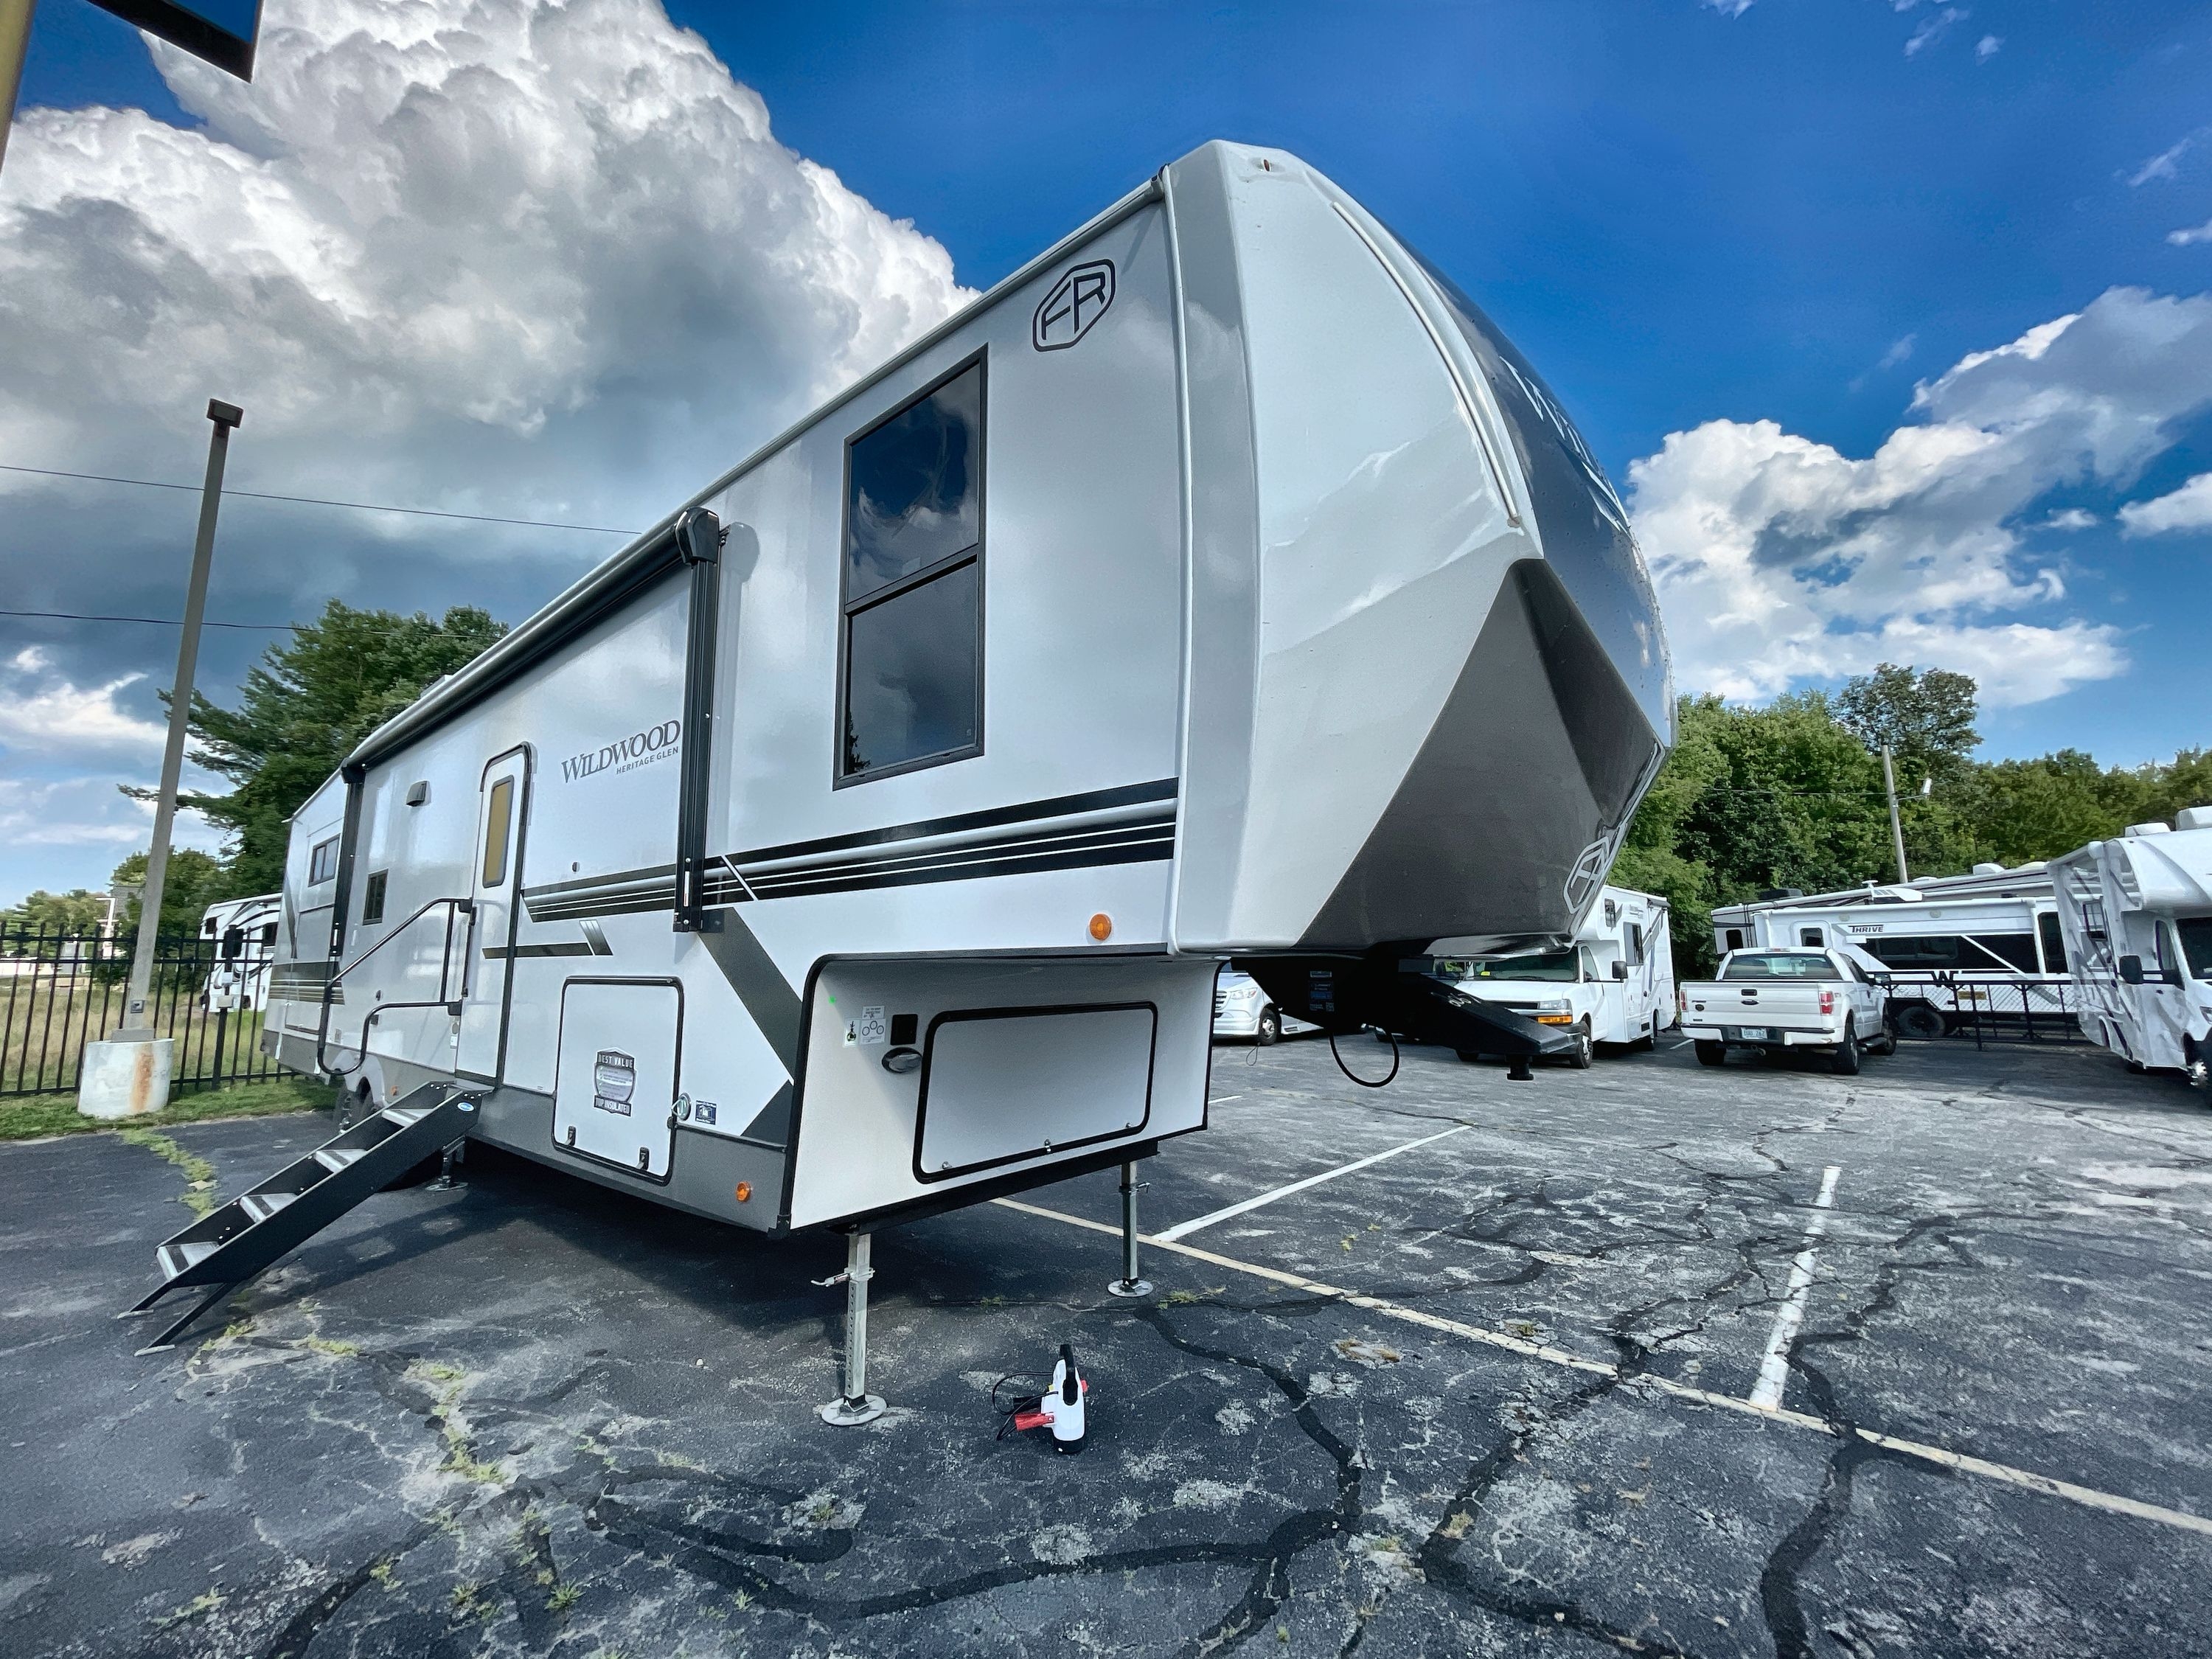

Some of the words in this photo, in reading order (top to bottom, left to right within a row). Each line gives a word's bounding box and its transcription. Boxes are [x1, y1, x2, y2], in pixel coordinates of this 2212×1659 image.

[561, 720, 681, 783] WILDWOOD
[616, 754, 655, 775] HERITAGE
[656, 746, 678, 760] GLEN
[1847, 924, 1884, 933] THRIVE
[598, 1054, 613, 1064] BEST
[614, 1056, 633, 1068] VALUE
